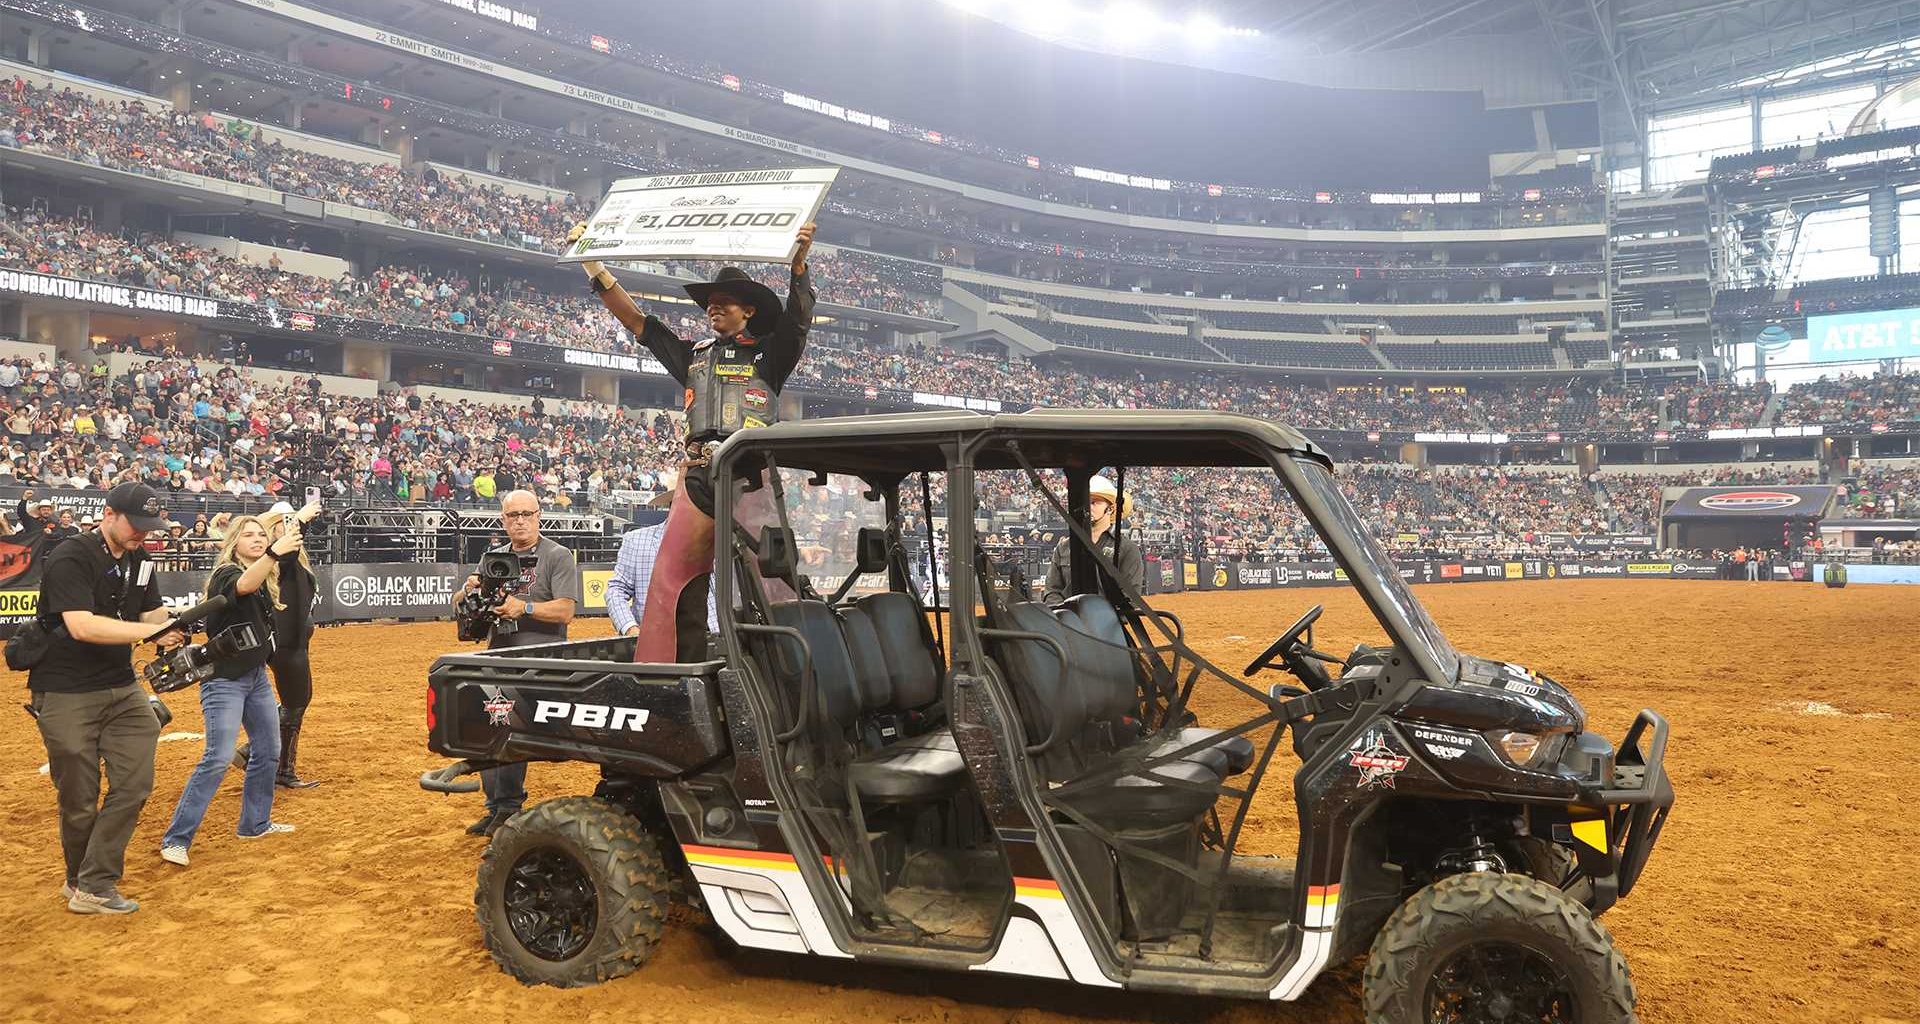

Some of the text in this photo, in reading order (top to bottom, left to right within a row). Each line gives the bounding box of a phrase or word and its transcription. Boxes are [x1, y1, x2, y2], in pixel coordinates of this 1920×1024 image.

[375, 31, 387, 42] 22
[390, 35, 429, 55] EMMITT
[431, 46, 461, 64] SMITH
[563, 84, 575, 95] 73
[577, 88, 606, 103] LARRY
[606, 98, 634, 111] ALLEN
[777, 141, 799, 153] WARE
[648, 170, 794, 188] 2024 PBR WORLD CHAMPION
[636, 212, 797, 230] $1,000,000
[0, 271, 218, 318] CONGRATULATIONS, CASSIO DIAS!
[1822, 320, 1902, 351] AT&T
[50, 495, 107, 506] RAMPS THA
[1306, 568, 1333, 580] Priefert
[1486, 564, 1502, 577] YETI
[367, 576, 452, 593] BLACK RIFLE
[0, 594, 37, 611] ORGA
[367, 593, 453, 606] COFFEE COMPANY
[533, 699, 650, 732] PBR
[1414, 730, 1473, 747] DEFENDER
[1355, 756, 1405, 768] PBR
